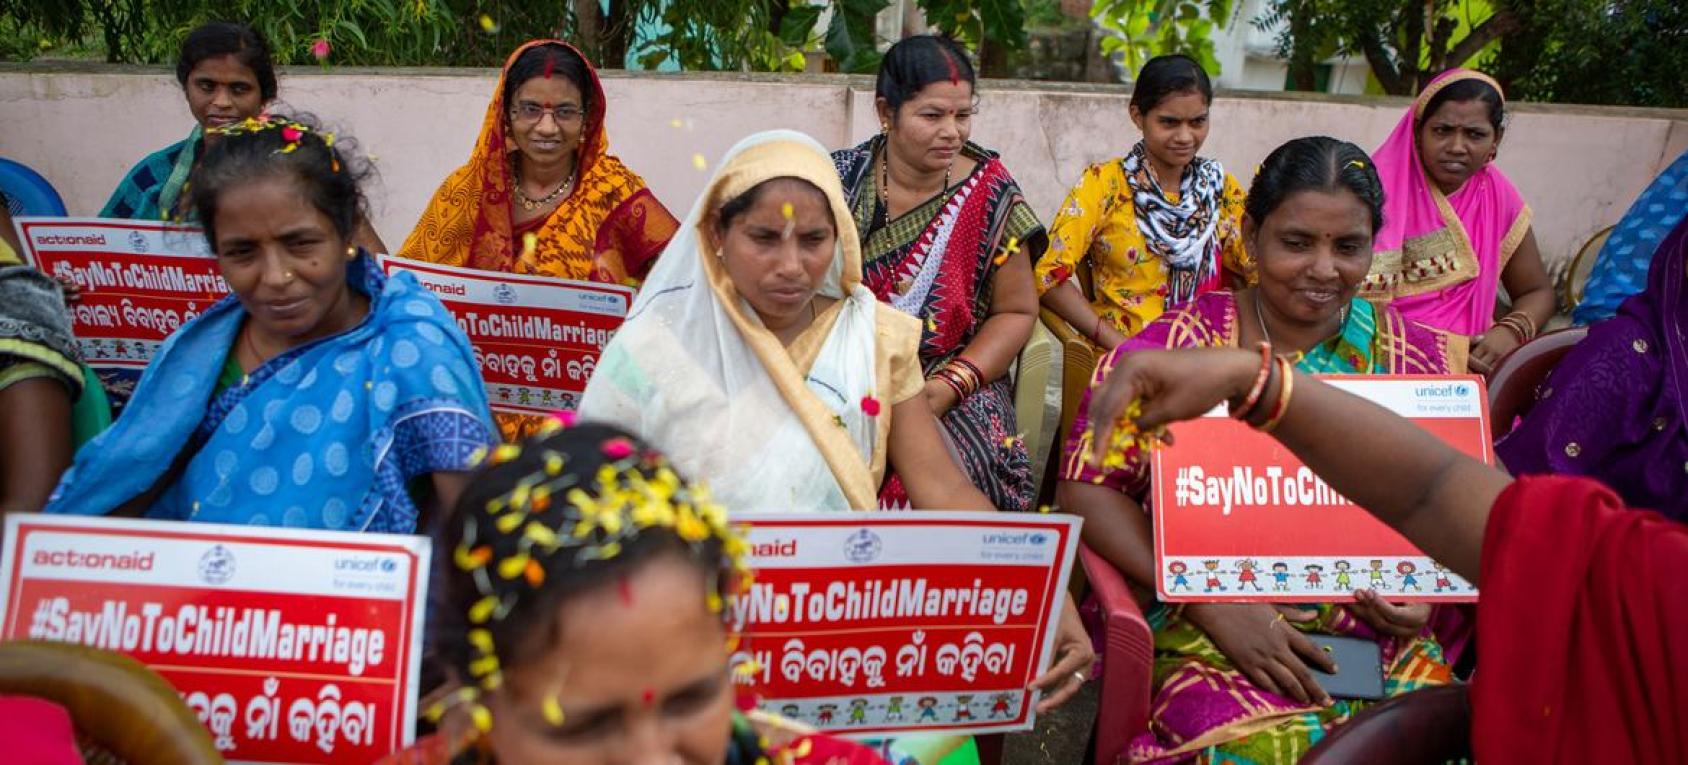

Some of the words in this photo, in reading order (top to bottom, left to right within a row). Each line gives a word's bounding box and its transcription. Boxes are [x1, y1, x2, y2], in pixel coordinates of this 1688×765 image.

[53, 260, 234, 294] #SayNoToChildMarria
[1415, 383, 1453, 397] unicef
[1175, 465, 1354, 516] #SayNoToCh
[982, 532, 1028, 545] unicef
[334, 556, 380, 571] unicef
[780, 637, 887, 688] ବିବାହକୁ
[895, 629, 928, 678] ନାଁ
[935, 631, 1017, 681] କହିବା
[245, 675, 280, 741] ନାଁ
[288, 683, 376, 755] କହିବା
